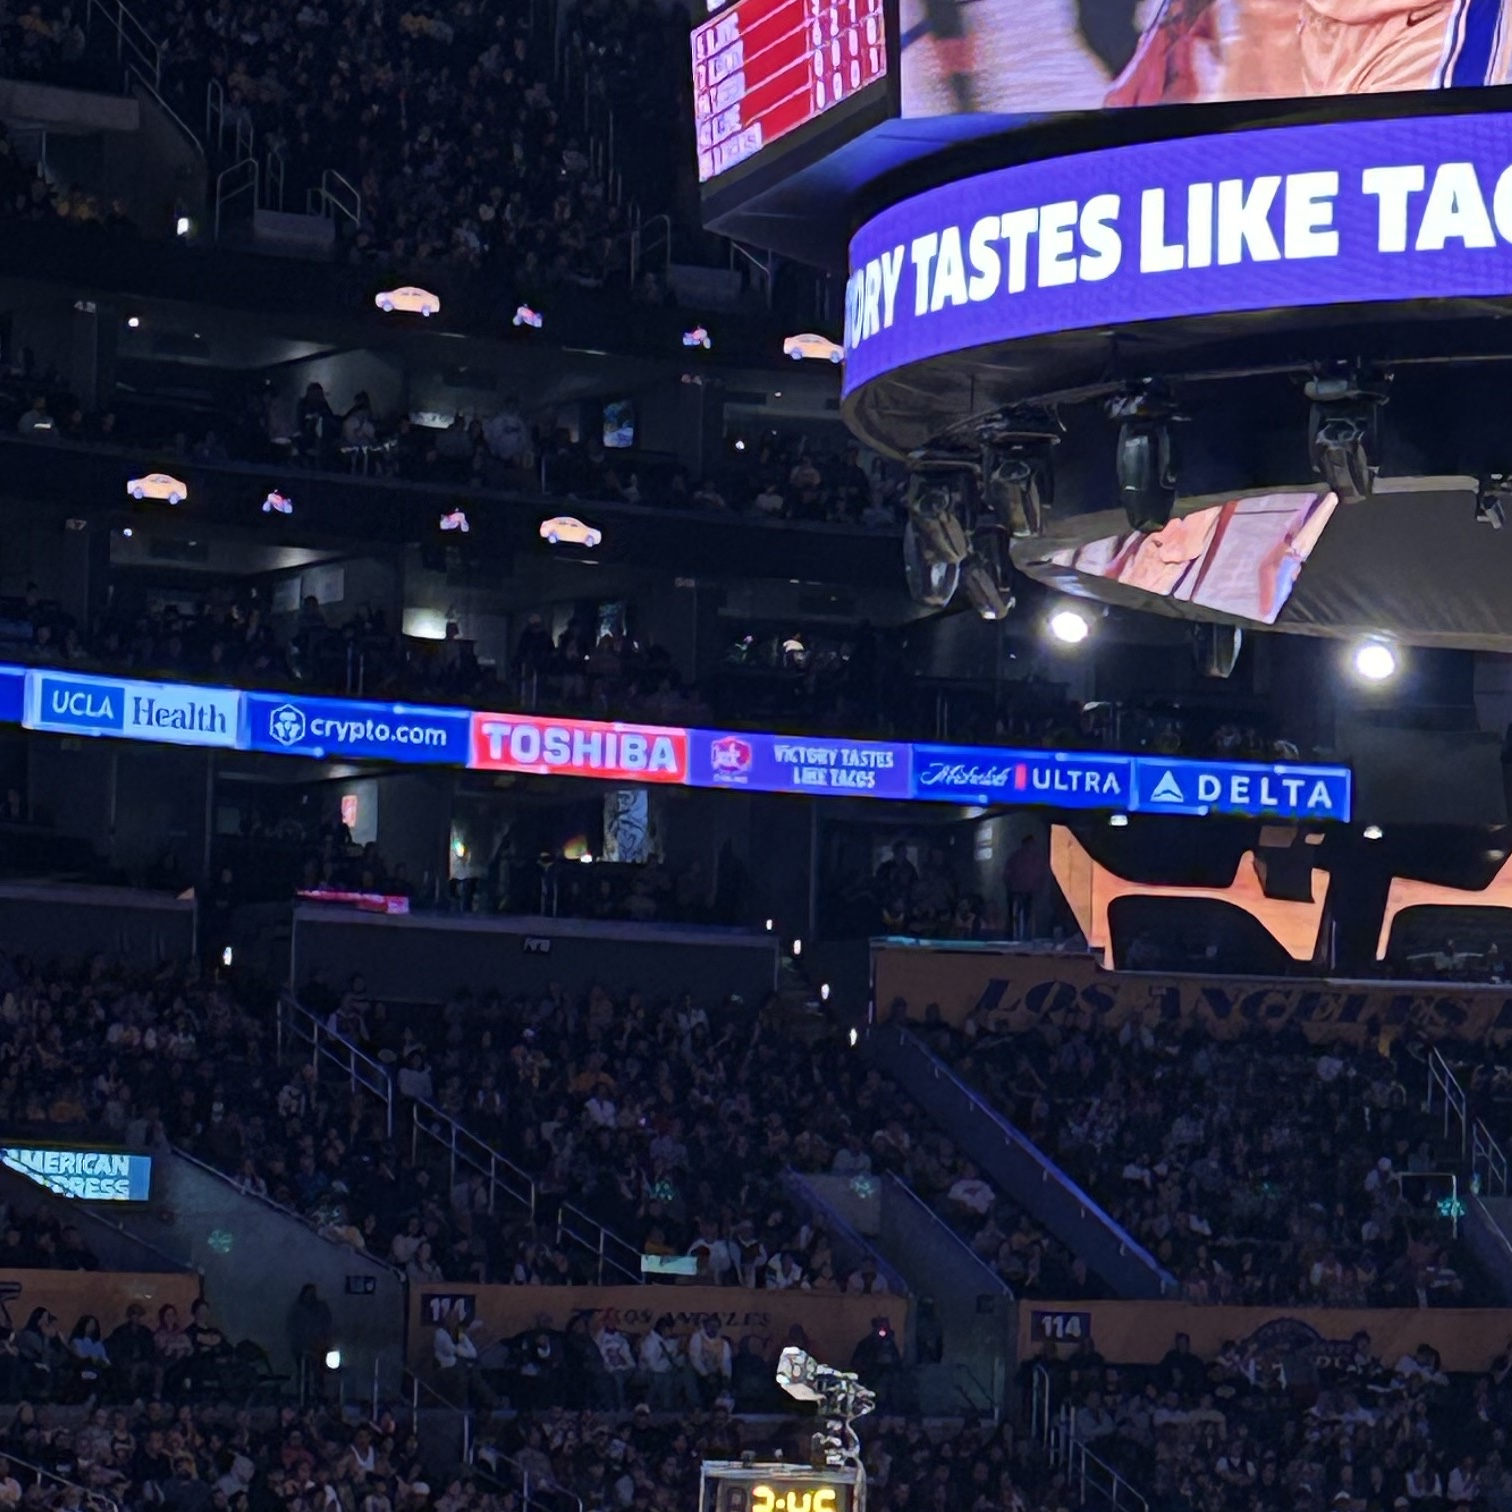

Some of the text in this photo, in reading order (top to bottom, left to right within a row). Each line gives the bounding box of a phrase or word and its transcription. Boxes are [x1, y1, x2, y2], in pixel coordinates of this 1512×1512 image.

[846, 243, 905, 349] ORY
[911, 194, 1122, 316] TASTES
[1140, 171, 1339, 273] LIKE
[51, 689, 227, 734] UCLA Health
[309, 713, 446, 748] crypto.com
[481, 721, 678, 774] TOSHIBA
[1032, 768, 1122, 795] ULTRA
[1197, 774, 1336, 809] DELTA
[1041, 1315, 1081, 1338] 114
